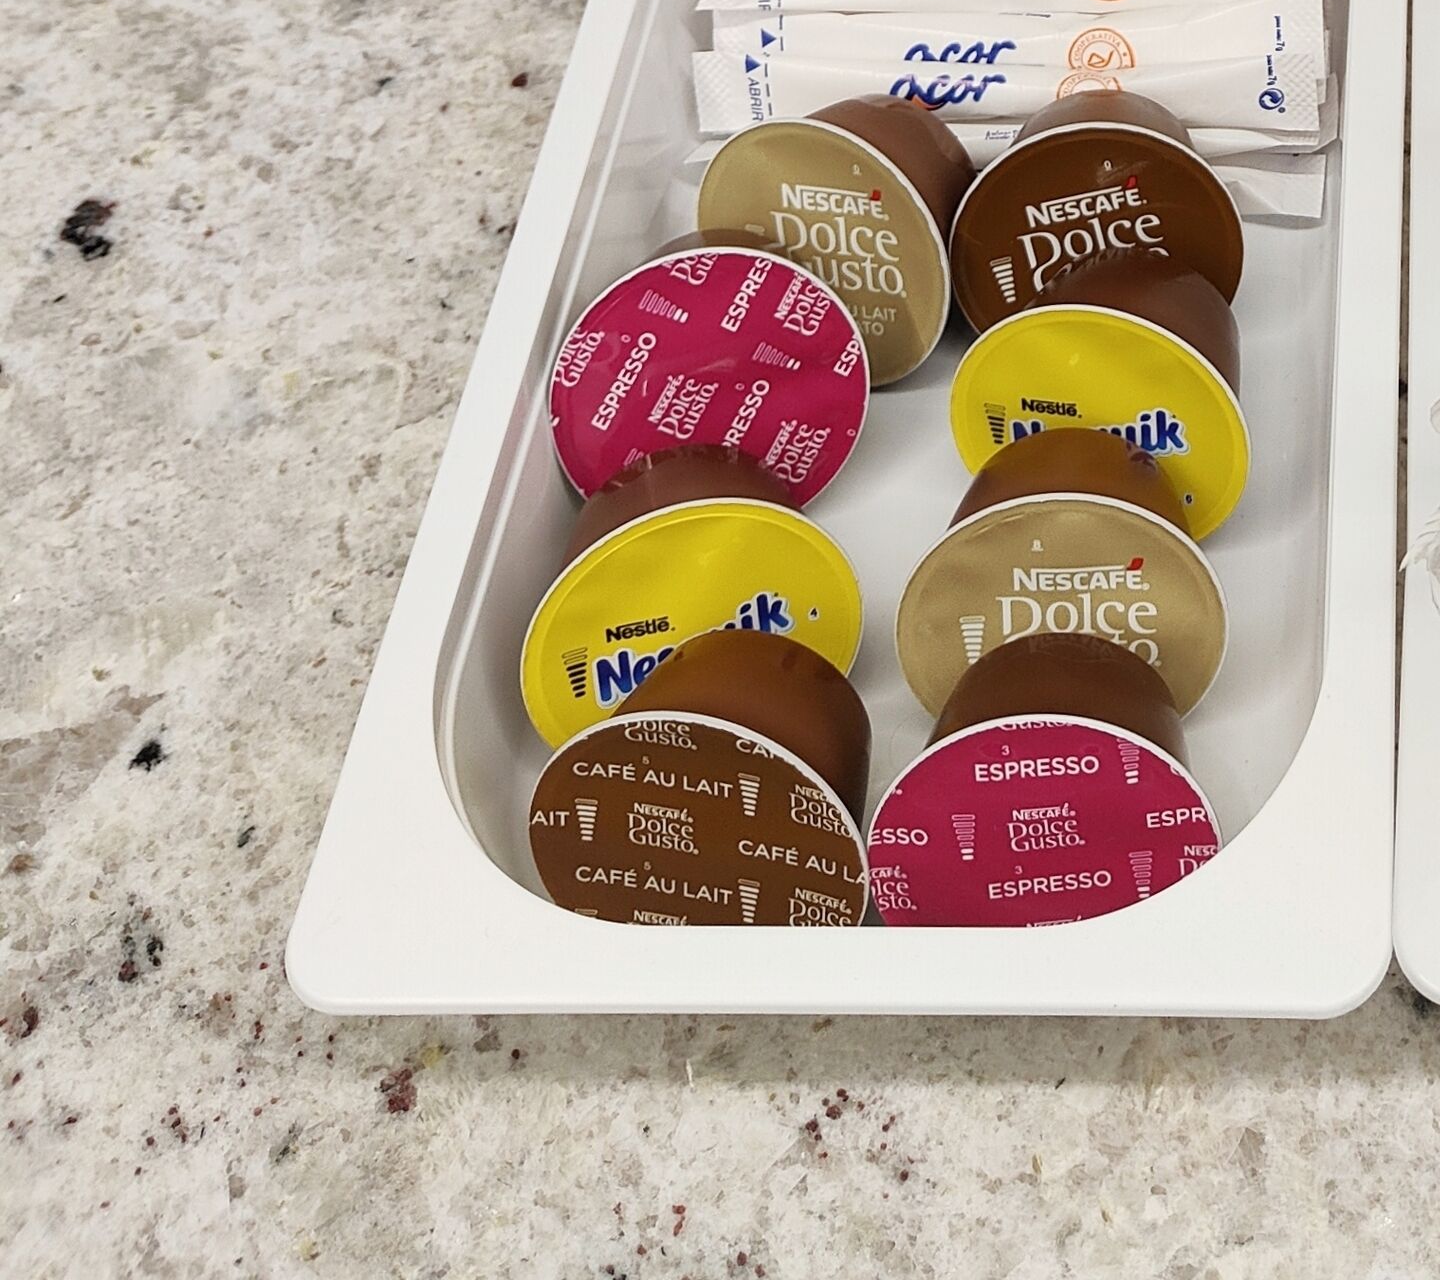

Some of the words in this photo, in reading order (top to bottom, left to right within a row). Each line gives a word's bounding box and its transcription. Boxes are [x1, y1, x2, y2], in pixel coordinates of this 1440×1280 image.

[1074, 33, 1121, 60] COOPERATIVA
[748, 77, 764, 122] ABRIR
[781, 183, 888, 220] NESCAFÉ
[1025, 175, 1146, 228] NESCAFÉ
[771, 211, 899, 261] Dolce
[1017, 213, 1164, 270] Dolce
[801, 252, 905, 298] usto
[861, 305, 897, 322] LAIT
[561, 331, 602, 387] Gusto
[591, 332, 657, 431] ESPRESSO
[657, 378, 702, 438] Dolce
[674, 383, 718, 440] Gusto
[1021, 397, 1078, 418] Nestlé
[788, 428, 830, 484] Gusto
[1012, 557, 1149, 592] NESCAFÉ
[605, 616, 671, 643] Nestlé
[996, 591, 1158, 635] Dolce
[624, 727, 694, 749] Gusto
[572, 761, 637, 782] CAFÉ
[643, 768, 676, 788] AU
[682, 775, 734, 799] LAIT
[974, 755, 1100, 782] ESPRESSO
[627, 812, 694, 840] Dolce
[634, 801, 692, 823] NESCAFÉ
[1012, 802, 1075, 821] NESCAFÉ
[628, 826, 697, 855] Gusto
[1007, 819, 1078, 840] Dolce
[1010, 833, 1083, 852] Gusto
[738, 840, 799, 866] CAFÉ
[805, 855, 837, 875] AU
[575, 866, 637, 888] CAFÉ
[644, 874, 676, 894] AU
[682, 884, 733, 906] LAIT
[794, 887, 850, 915] NESCAFÉ
[988, 870, 1112, 900] ESPRESSO
[788, 897, 852, 927] Dolce
